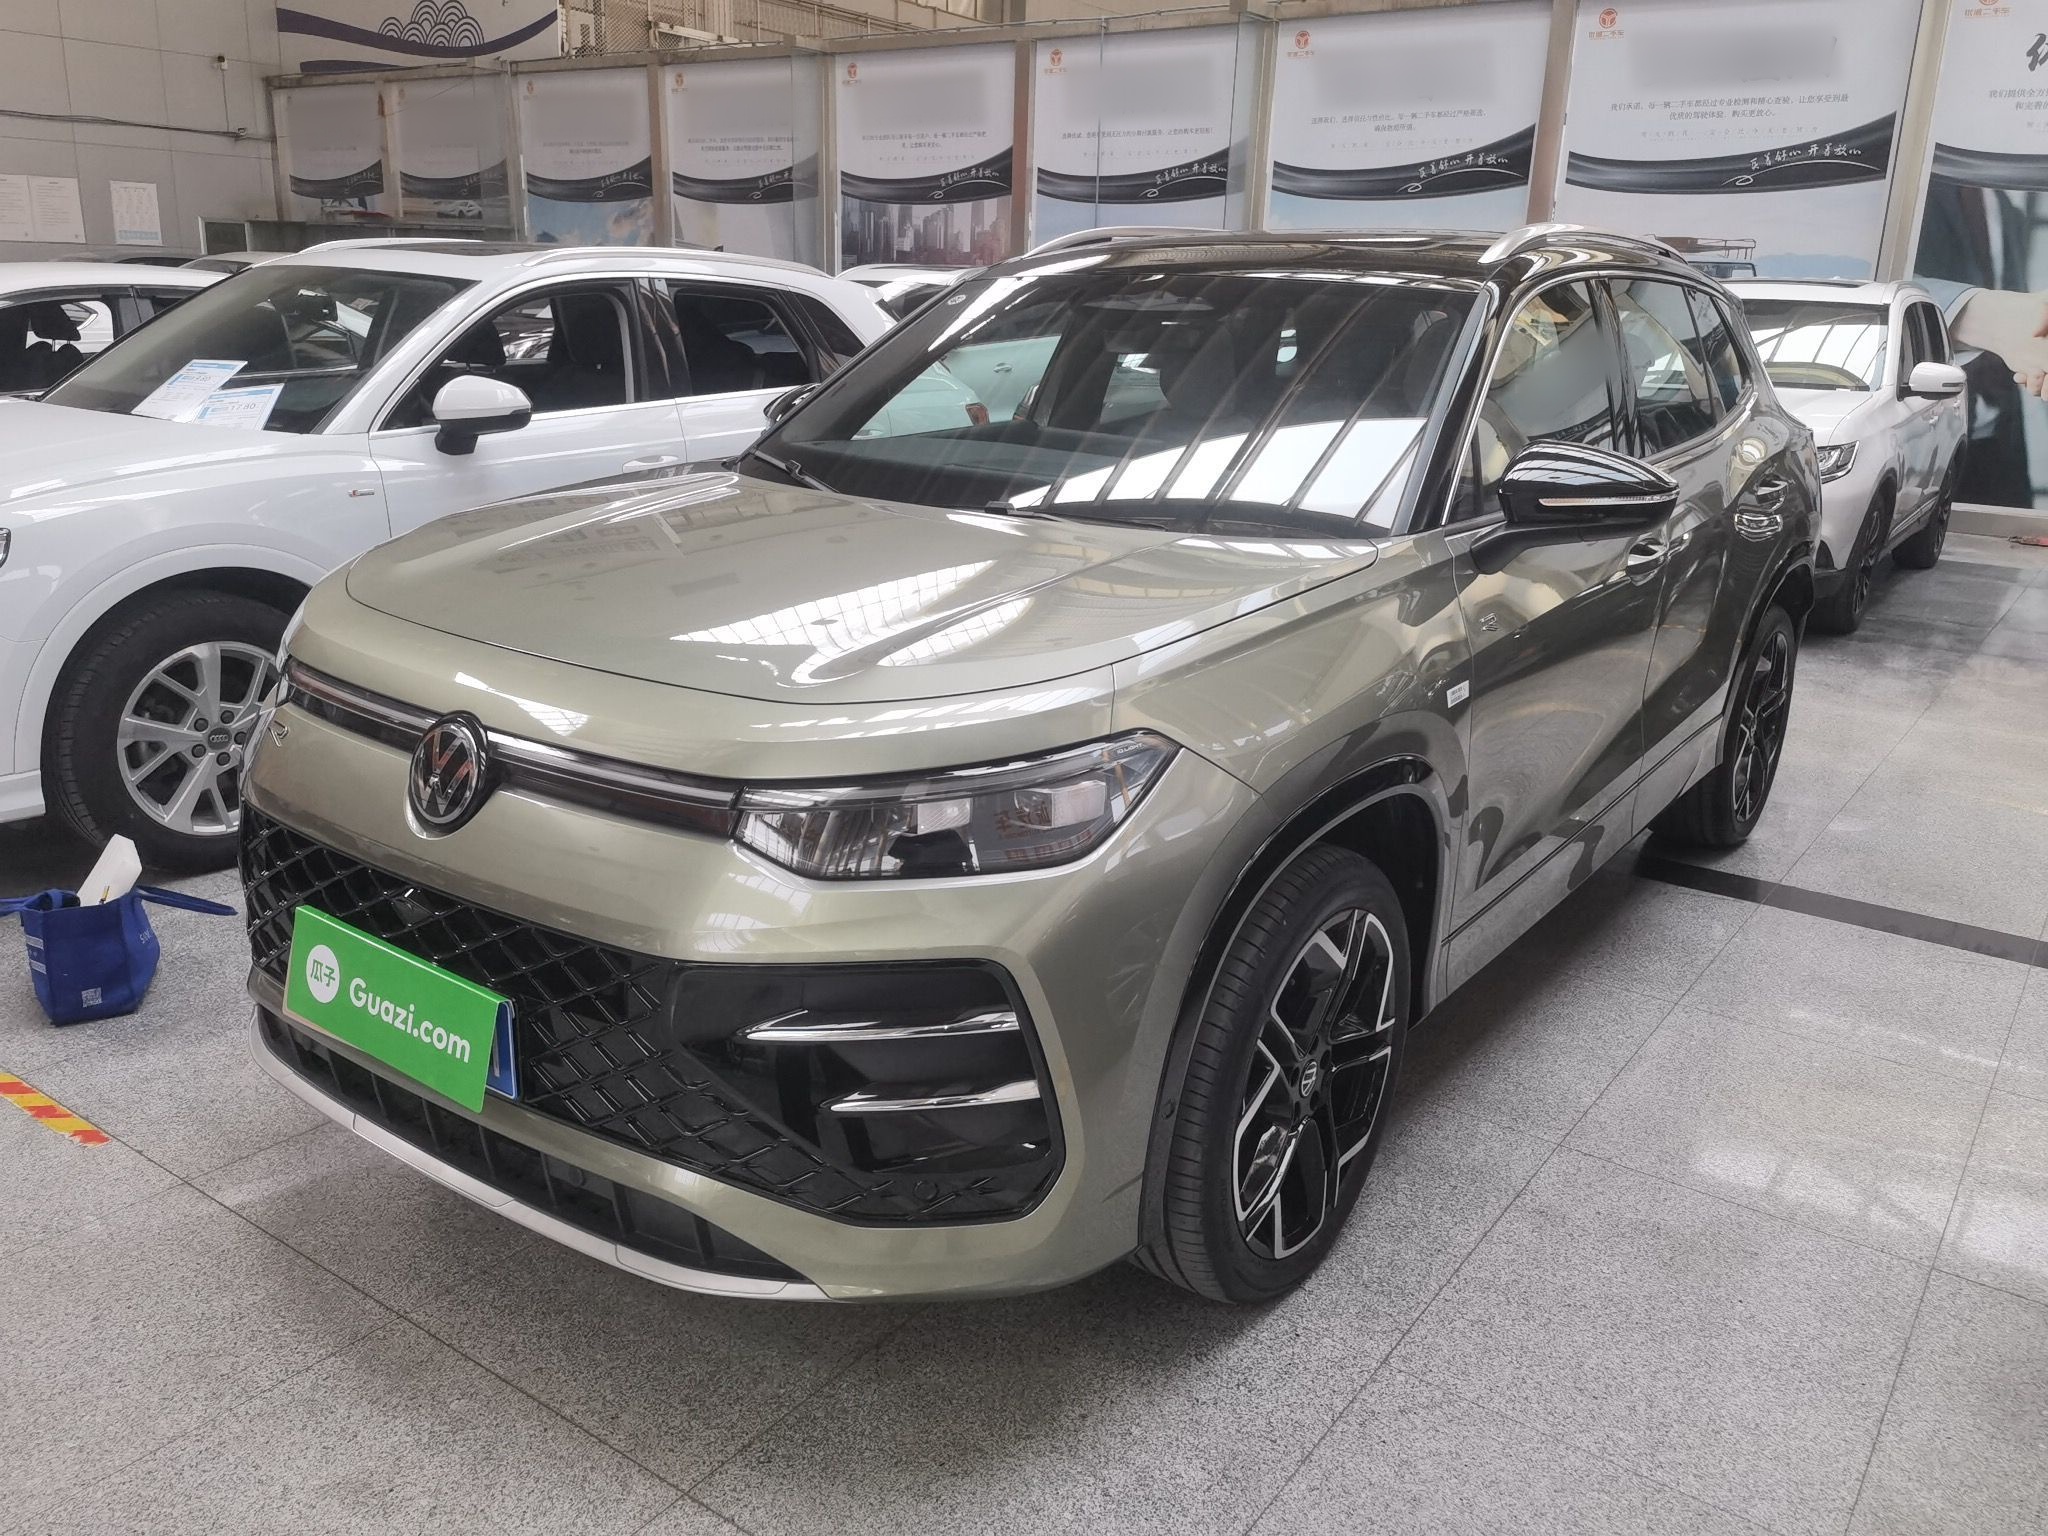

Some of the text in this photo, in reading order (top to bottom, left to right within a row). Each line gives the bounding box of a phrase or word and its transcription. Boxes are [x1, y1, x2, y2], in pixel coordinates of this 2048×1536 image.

[1989, 88, 2048, 99] 我们提供全方
[310, 958, 336, 988] 瓜子
[349, 977, 471, 1064] Guazi.com
